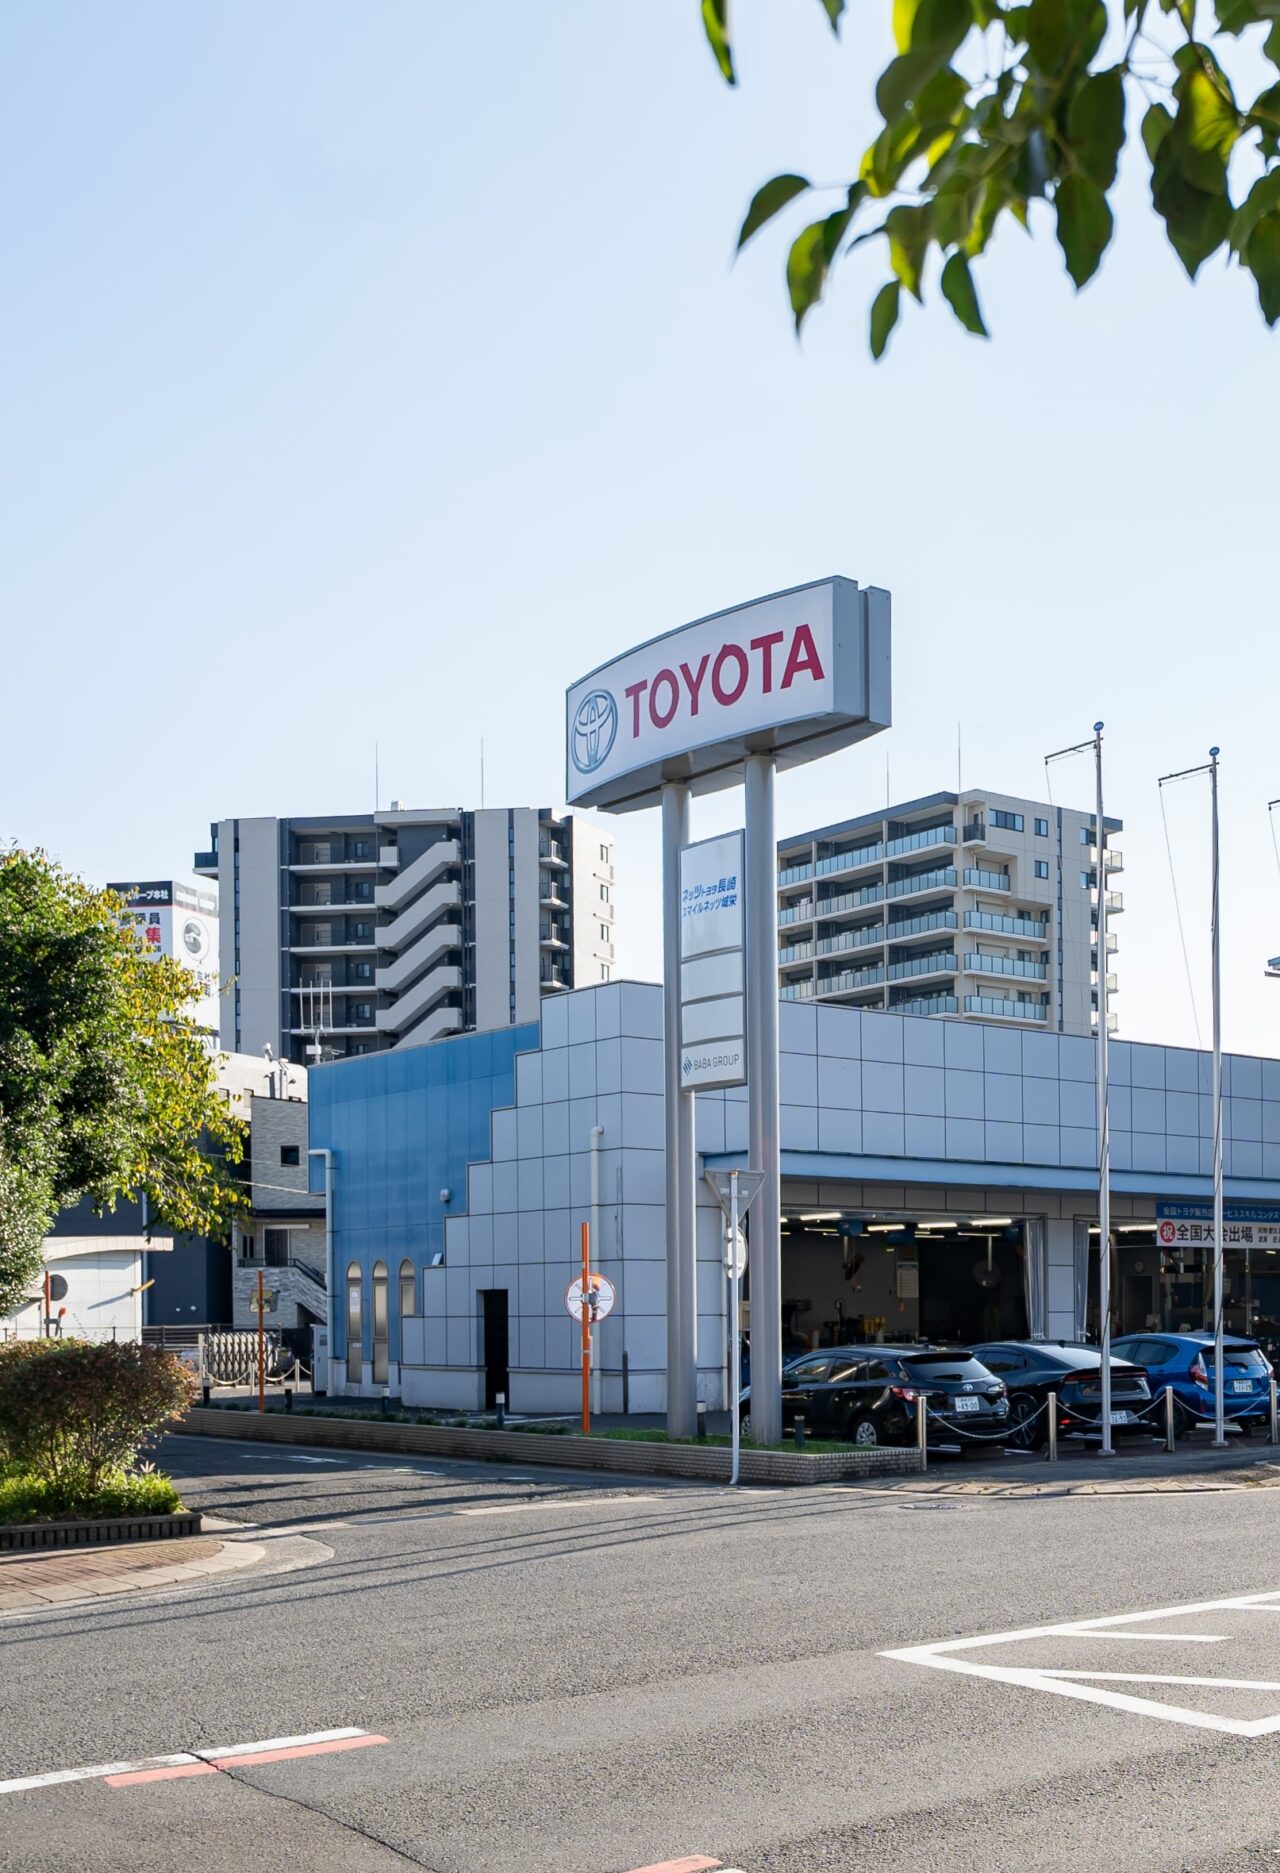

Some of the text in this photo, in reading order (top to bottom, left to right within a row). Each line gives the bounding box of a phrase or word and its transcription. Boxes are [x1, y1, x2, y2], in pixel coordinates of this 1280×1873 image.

[625, 623, 825, 739] TOYOTA
[682, 876, 737, 902] ネッツトヨタ長崎
[693, 1053, 740, 1070] BABA GROUP
[1162, 1224, 1174, 1240] 祝
